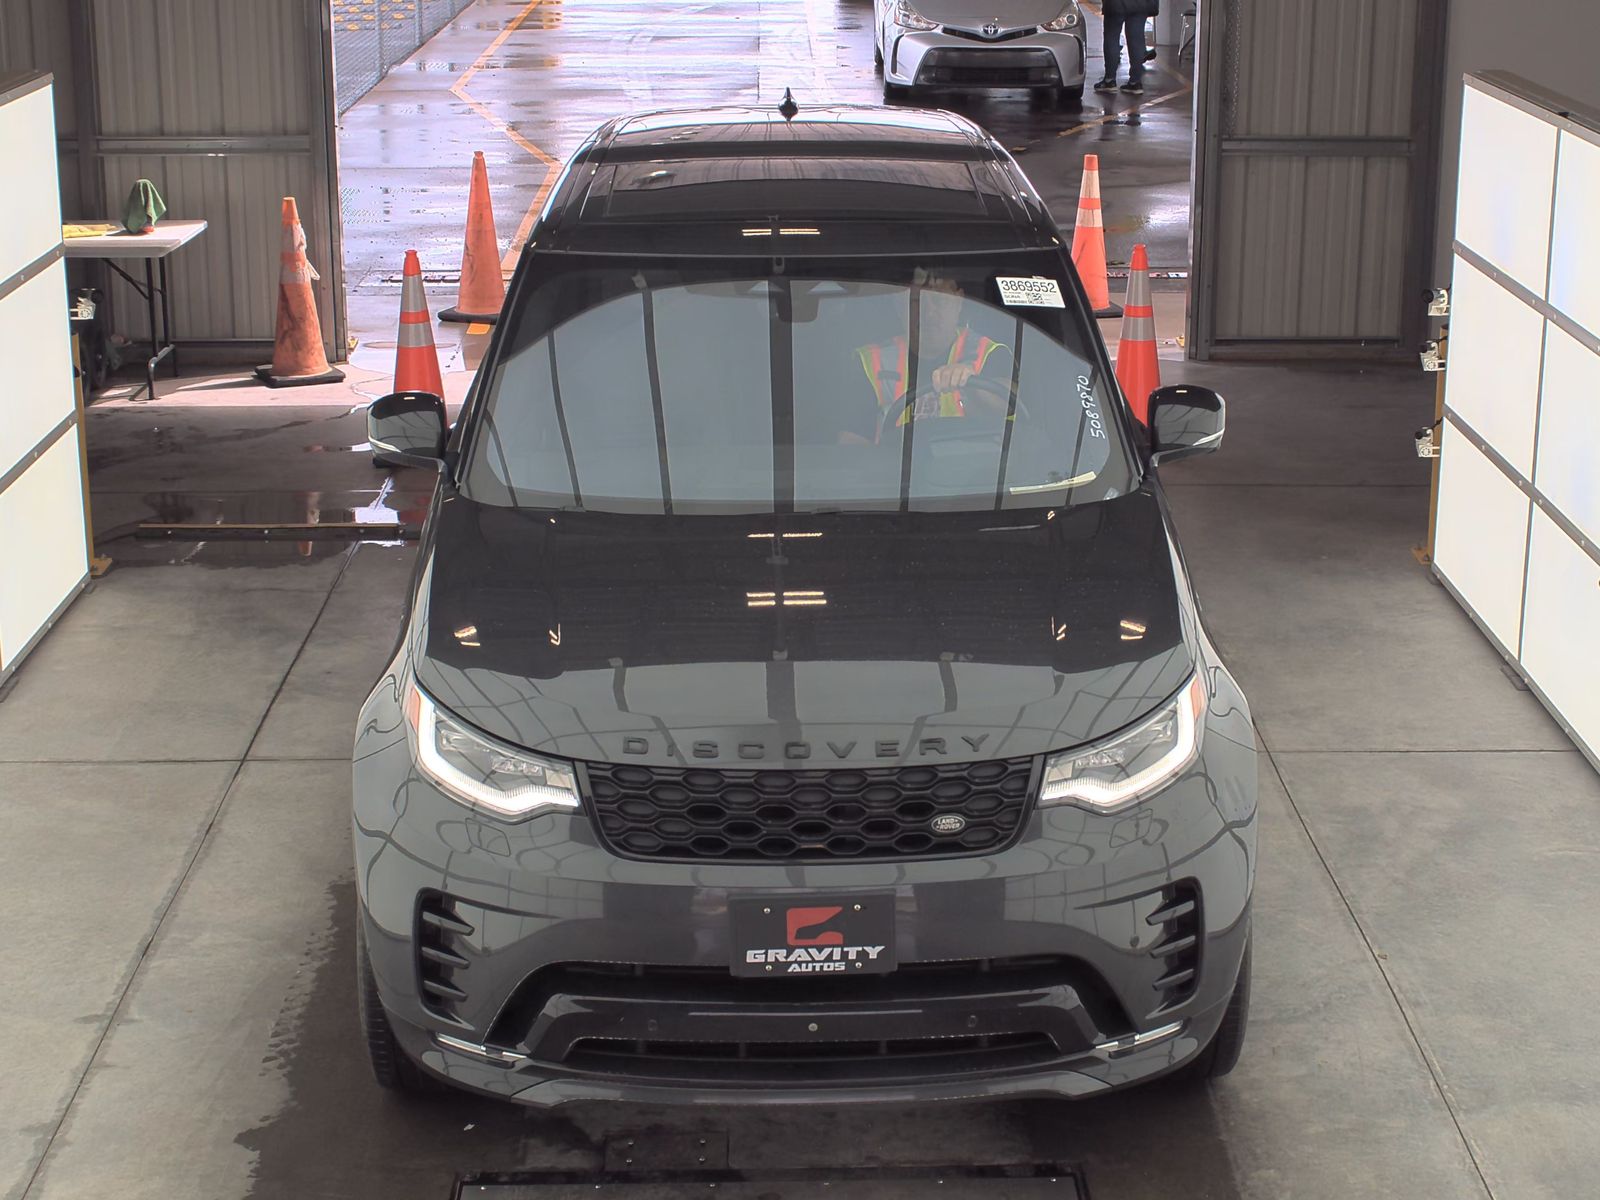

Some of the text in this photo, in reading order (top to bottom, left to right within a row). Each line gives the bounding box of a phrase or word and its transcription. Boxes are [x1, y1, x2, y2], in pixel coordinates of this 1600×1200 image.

[1001, 280, 1056, 293] 3869552
[1077, 375, 1105, 439] 5089870
[623, 733, 989, 759] DISCOVERY
[940, 822, 960, 830] ROVER
[746, 946, 885, 963] GRAVITY
[787, 962, 845, 972] AUTOS
